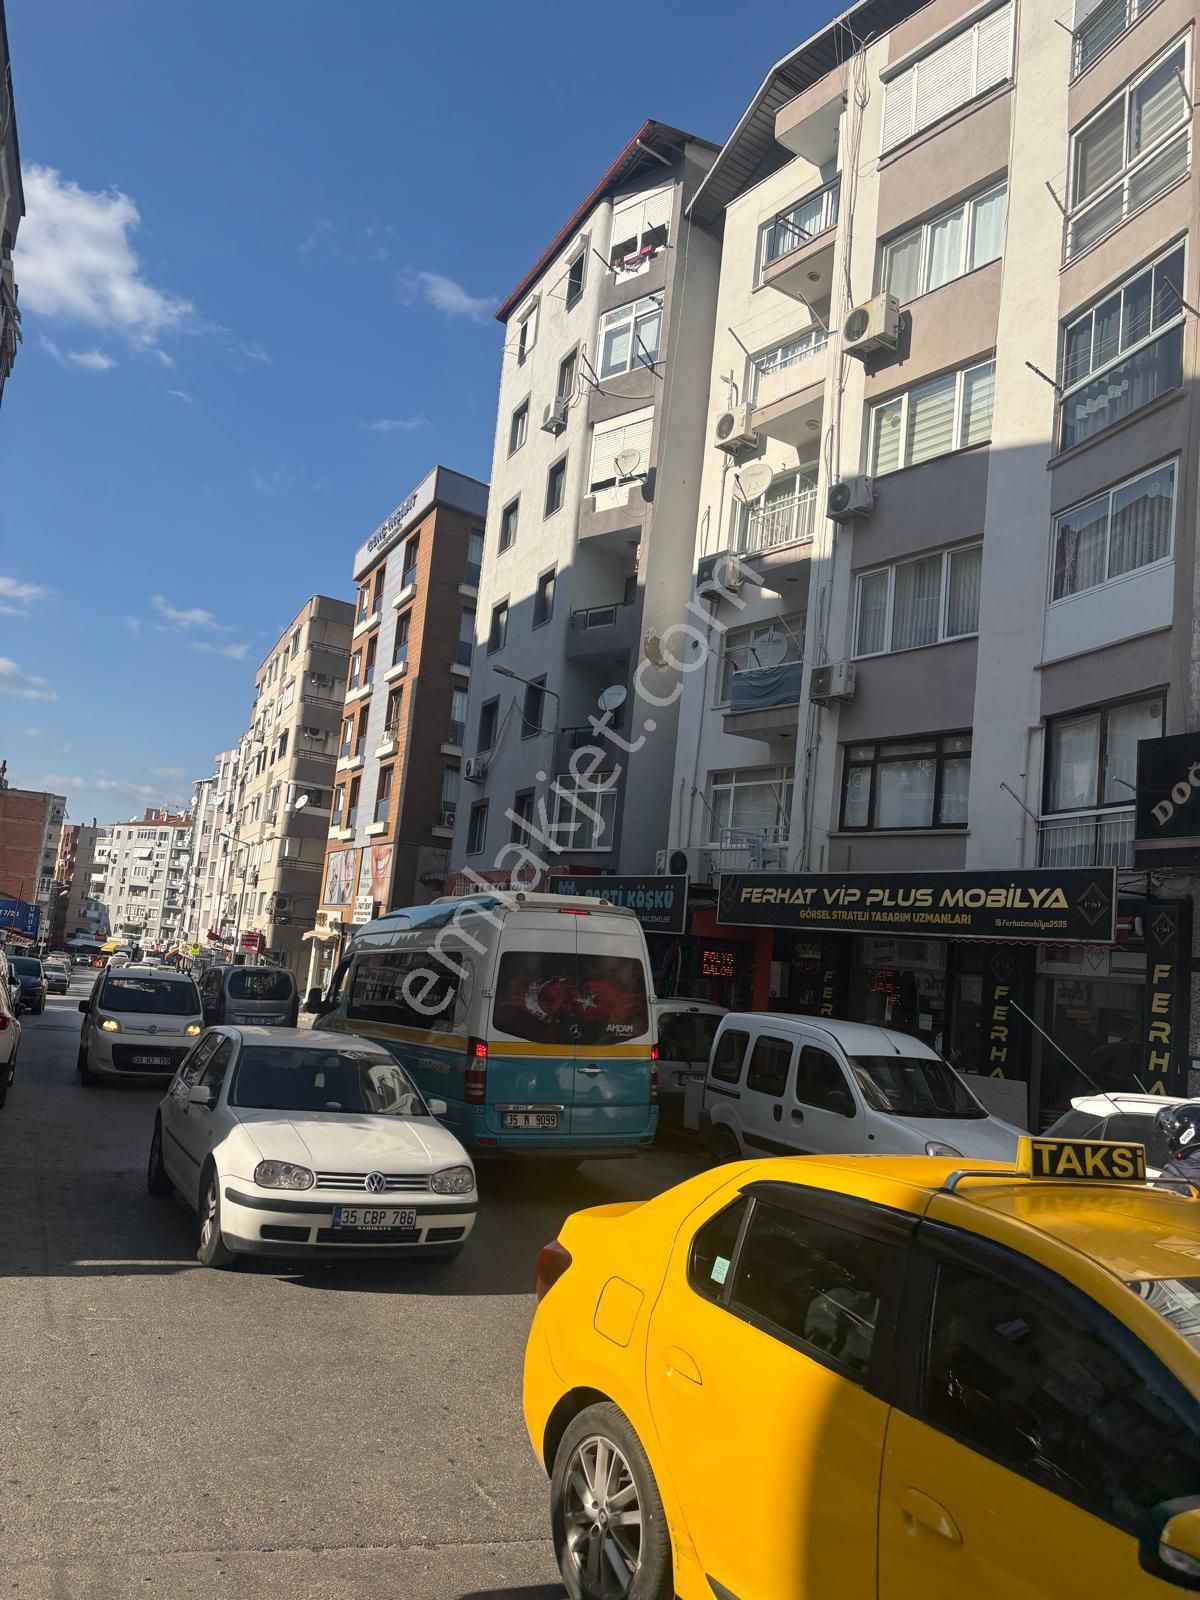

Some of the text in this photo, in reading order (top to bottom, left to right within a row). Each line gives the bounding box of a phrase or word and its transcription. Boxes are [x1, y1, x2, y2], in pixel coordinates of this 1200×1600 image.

[627, 884, 674, 910] KÖŞKÜ
[740, 883, 1069, 909] FERHAT VİP PLUS MOBİLYA
[800, 908, 971, 925] GÖRSEL STRATEJİ TASARIM UZMANLARI
[508, 1114, 518, 1125] 35
[536, 1114, 556, 1126] 9099
[342, 1210, 415, 1225] 35 CBP 786
